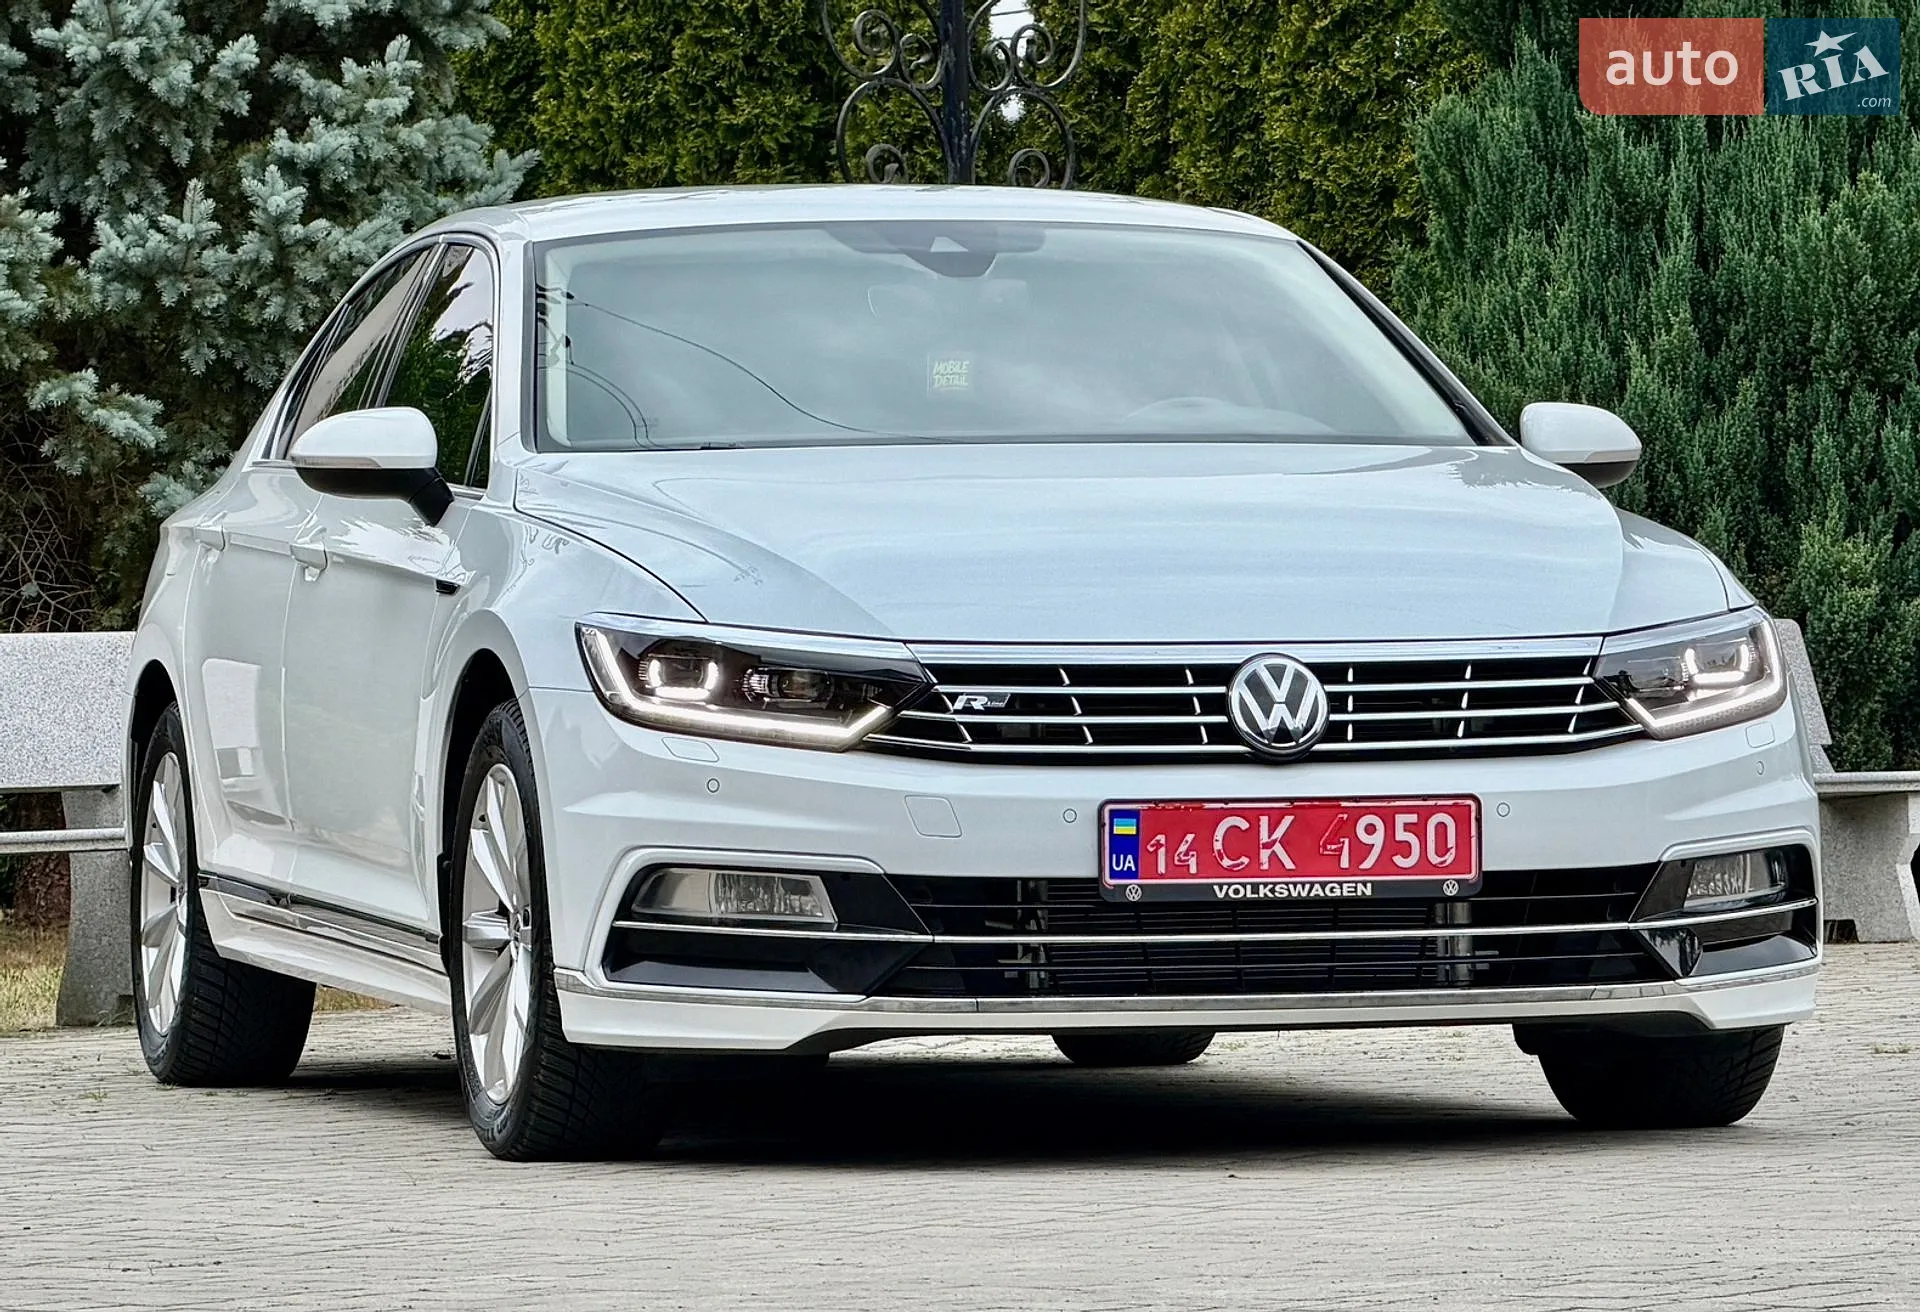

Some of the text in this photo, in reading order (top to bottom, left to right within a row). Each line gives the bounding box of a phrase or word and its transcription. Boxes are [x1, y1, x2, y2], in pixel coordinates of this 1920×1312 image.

[1146, 812, 1457, 875] 14 CK 4950
[1111, 854, 1136, 872] UA
[1212, 882, 1373, 899] VOLKSWAGEN
